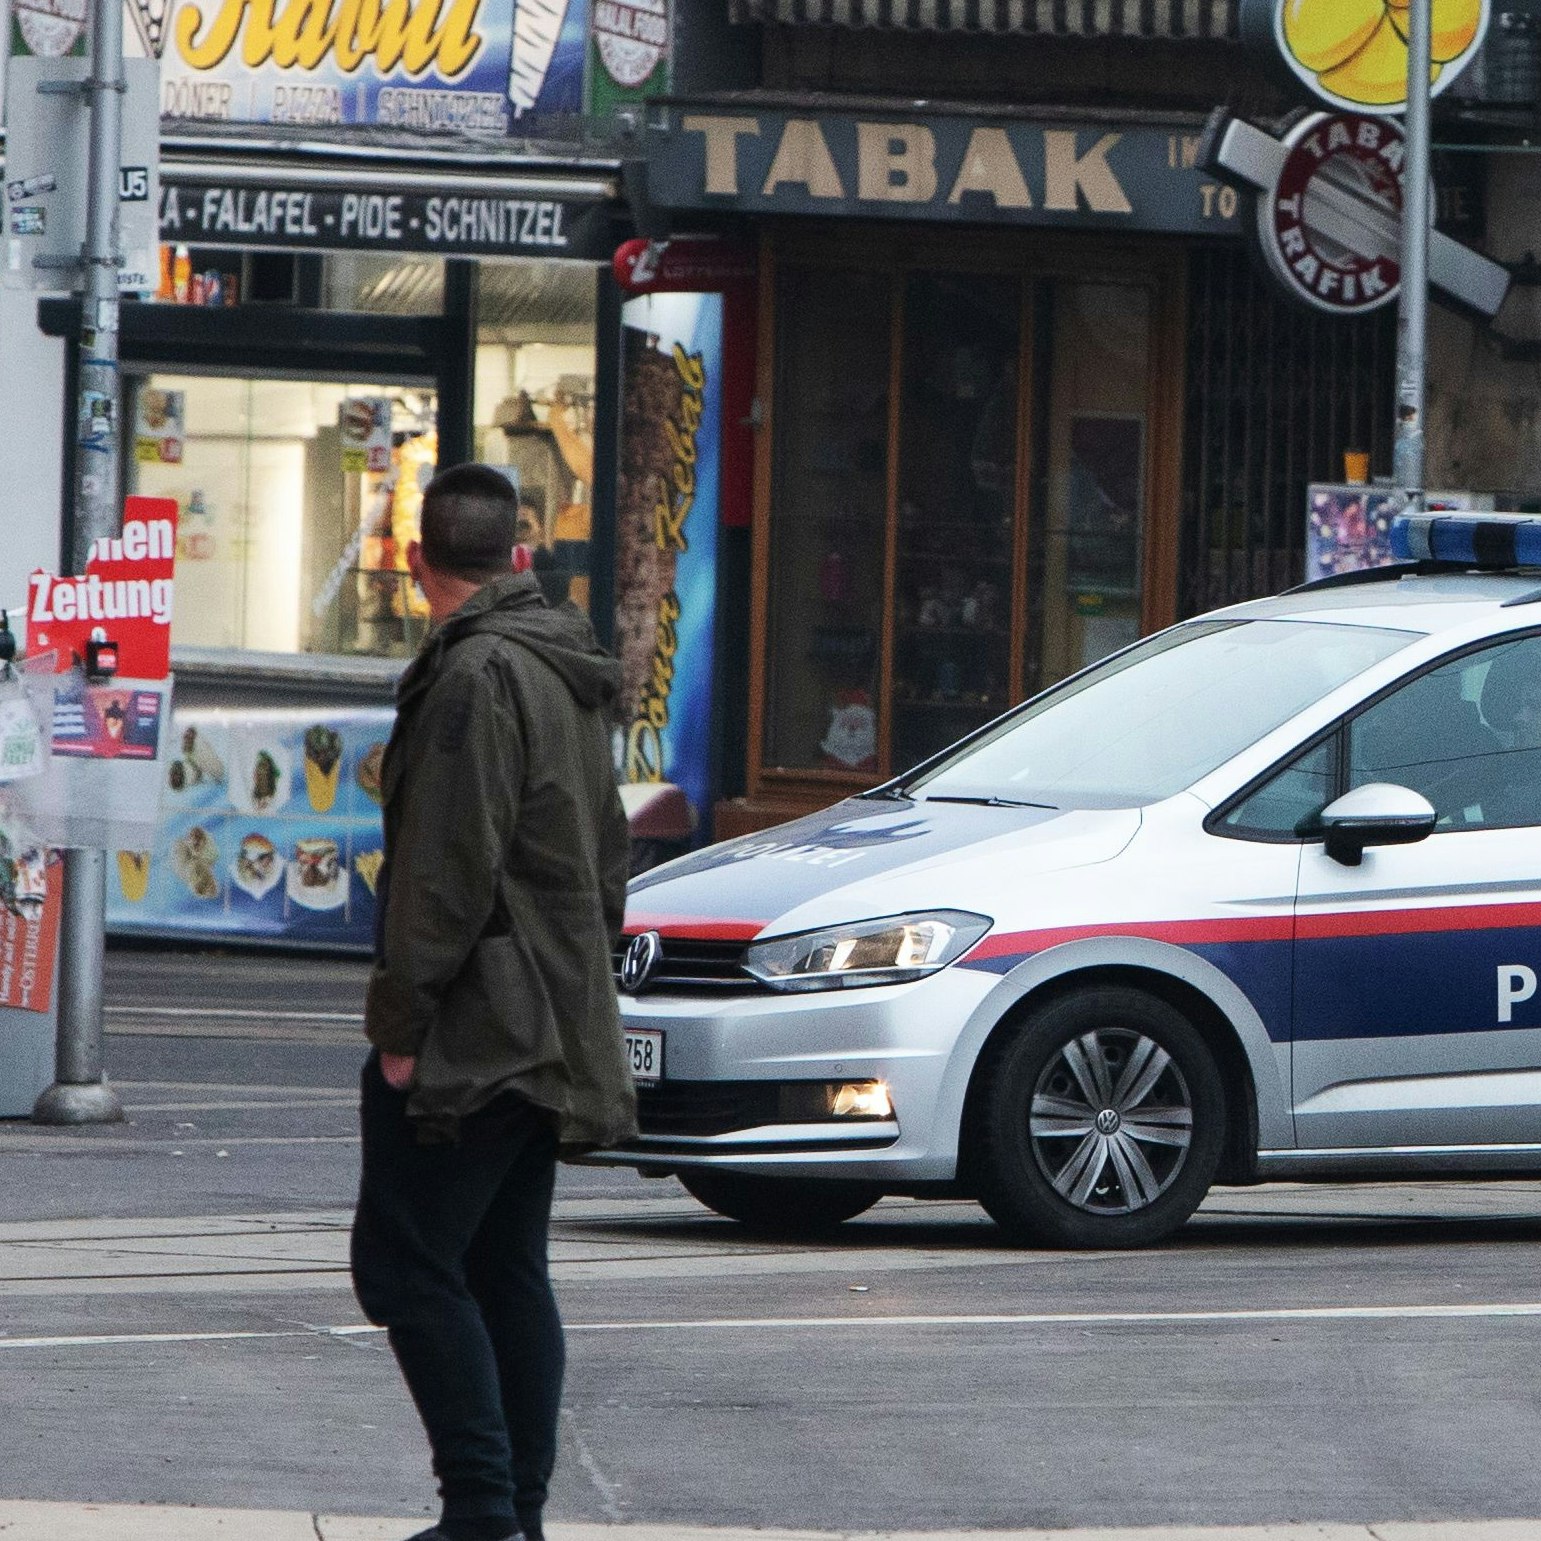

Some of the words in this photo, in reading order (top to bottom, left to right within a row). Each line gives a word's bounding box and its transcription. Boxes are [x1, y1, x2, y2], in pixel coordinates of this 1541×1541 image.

[164, 79, 232, 119] DÖNER
[273, 86, 342, 122] PIZZA
[379, 87, 507, 132] SCHNITZEL
[682, 115, 1133, 213] TABAK
[202, 188, 317, 236] FALAFEL
[340, 194, 402, 239] PIDE
[424, 199, 568, 246] SCHNITZEL
[1279, 195, 1386, 301] TRAFIK
[29, 573, 174, 624] Zeitung
